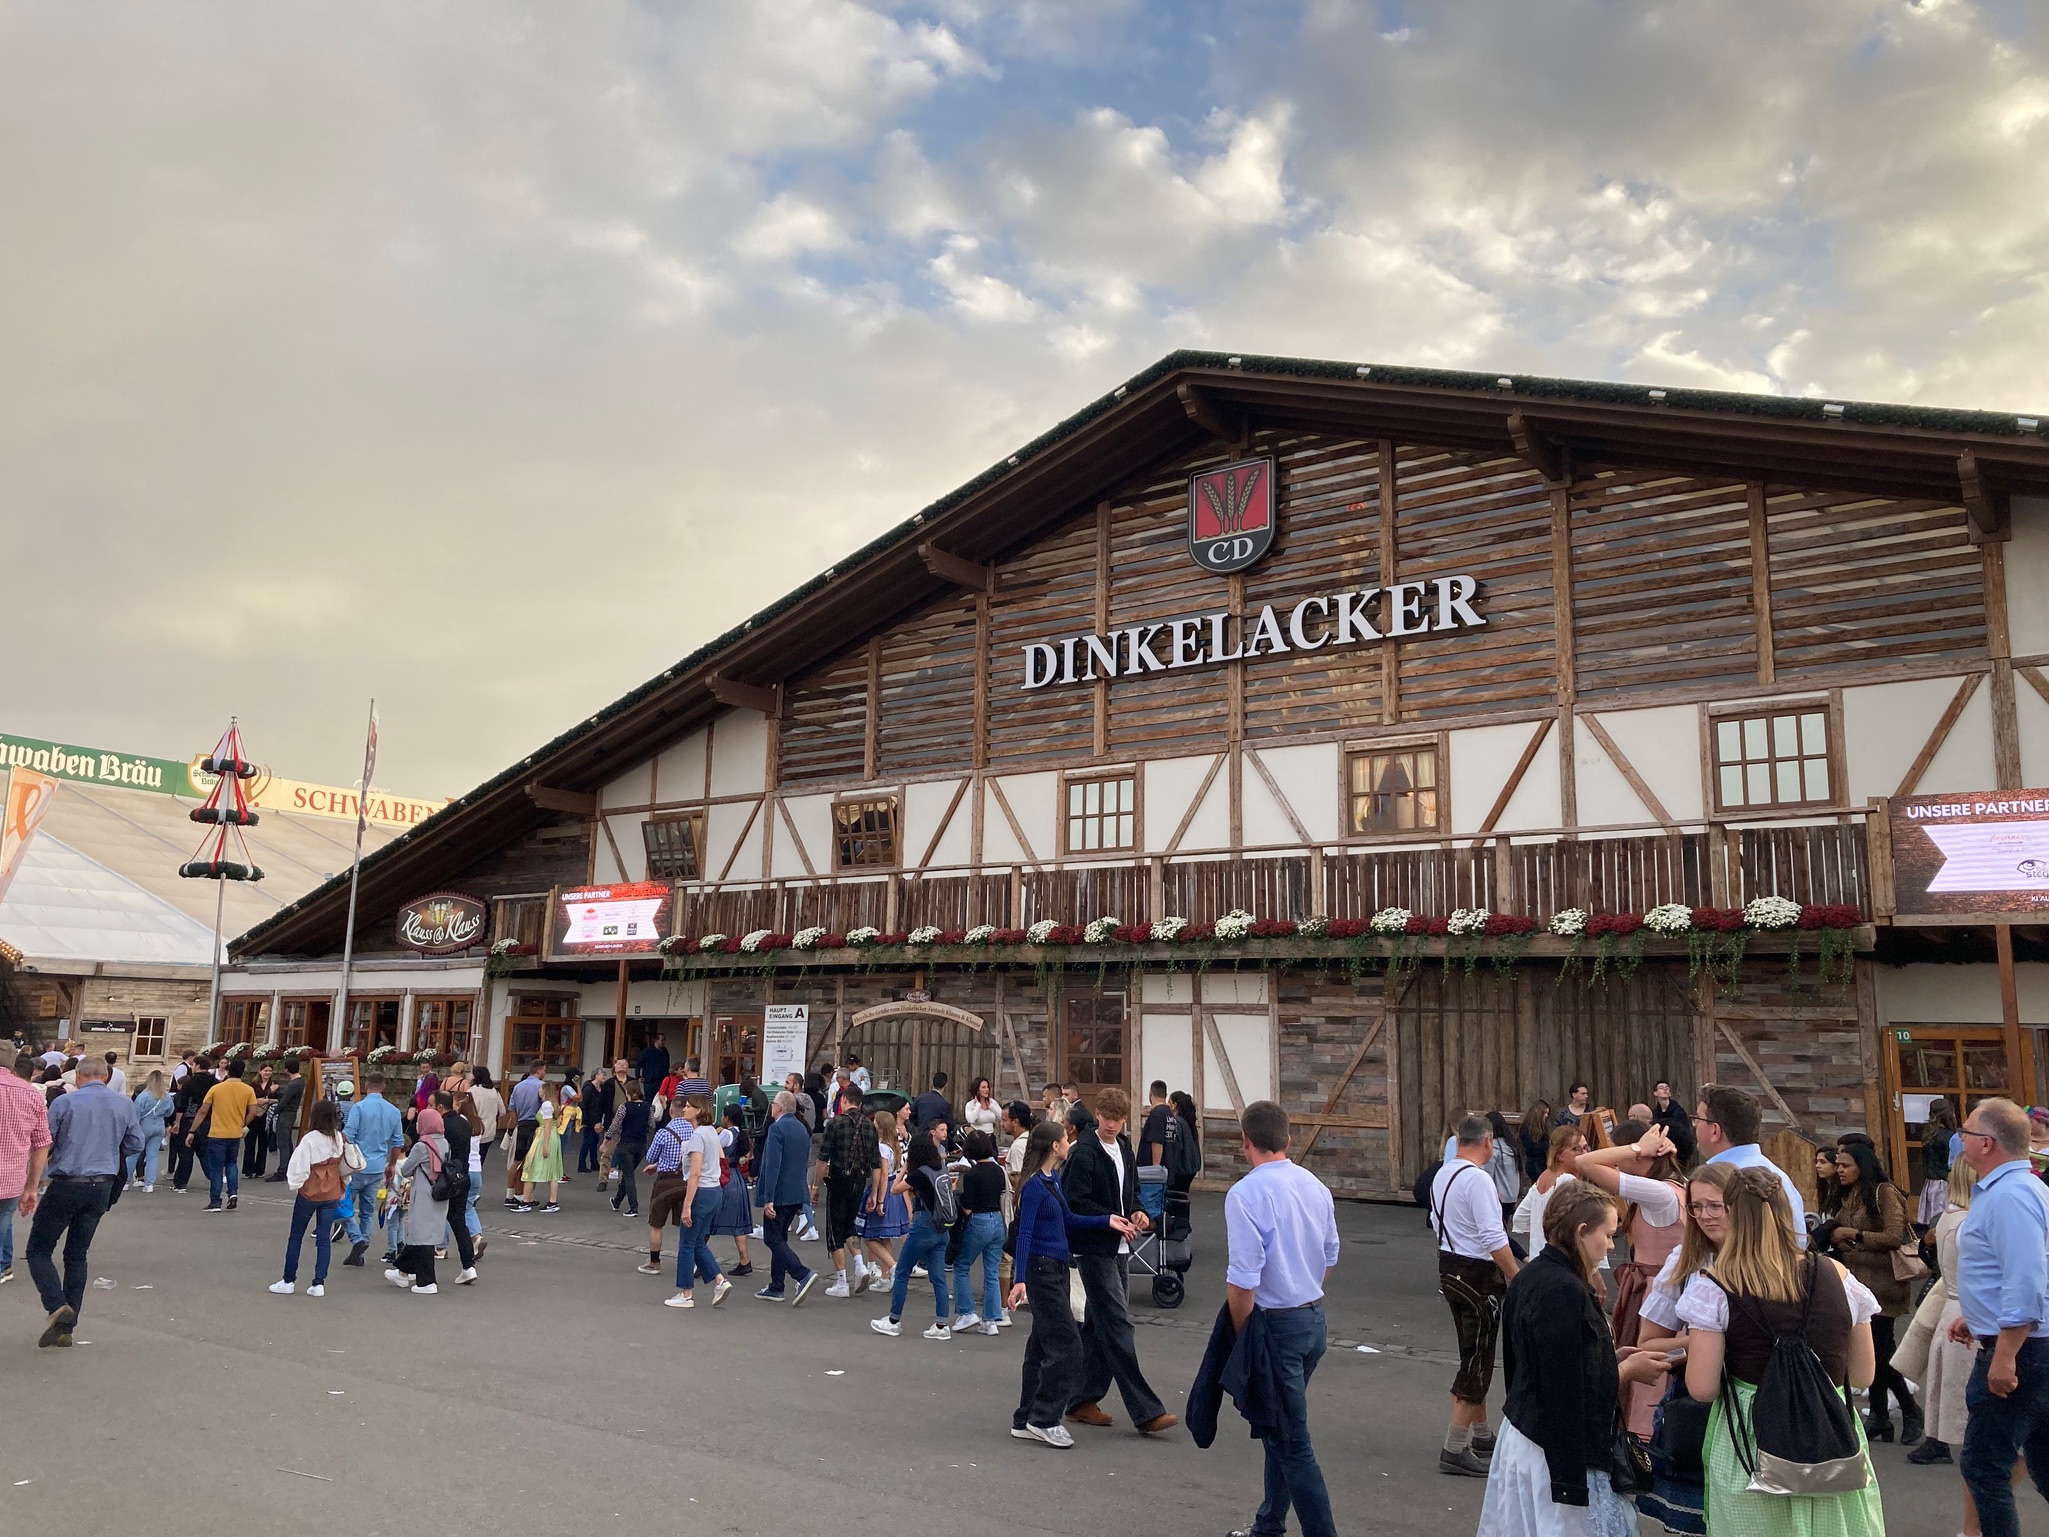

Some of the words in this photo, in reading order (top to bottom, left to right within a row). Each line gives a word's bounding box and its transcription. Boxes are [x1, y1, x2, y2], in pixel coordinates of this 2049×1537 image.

[1208, 537, 1254, 563] CD
[1020, 574, 1488, 690] DINKELACKER
[98, 754, 162, 788] Bräu
[1907, 803, 1971, 819] UNSERE
[562, 892, 583, 901] UNSERE
[584, 890, 610, 899] PARTNER
[401, 909, 433, 945] Klauss
[444, 910, 480, 942] Klauss
[794, 1007, 805, 1019] A
[1897, 1031, 1910, 1040] 10
